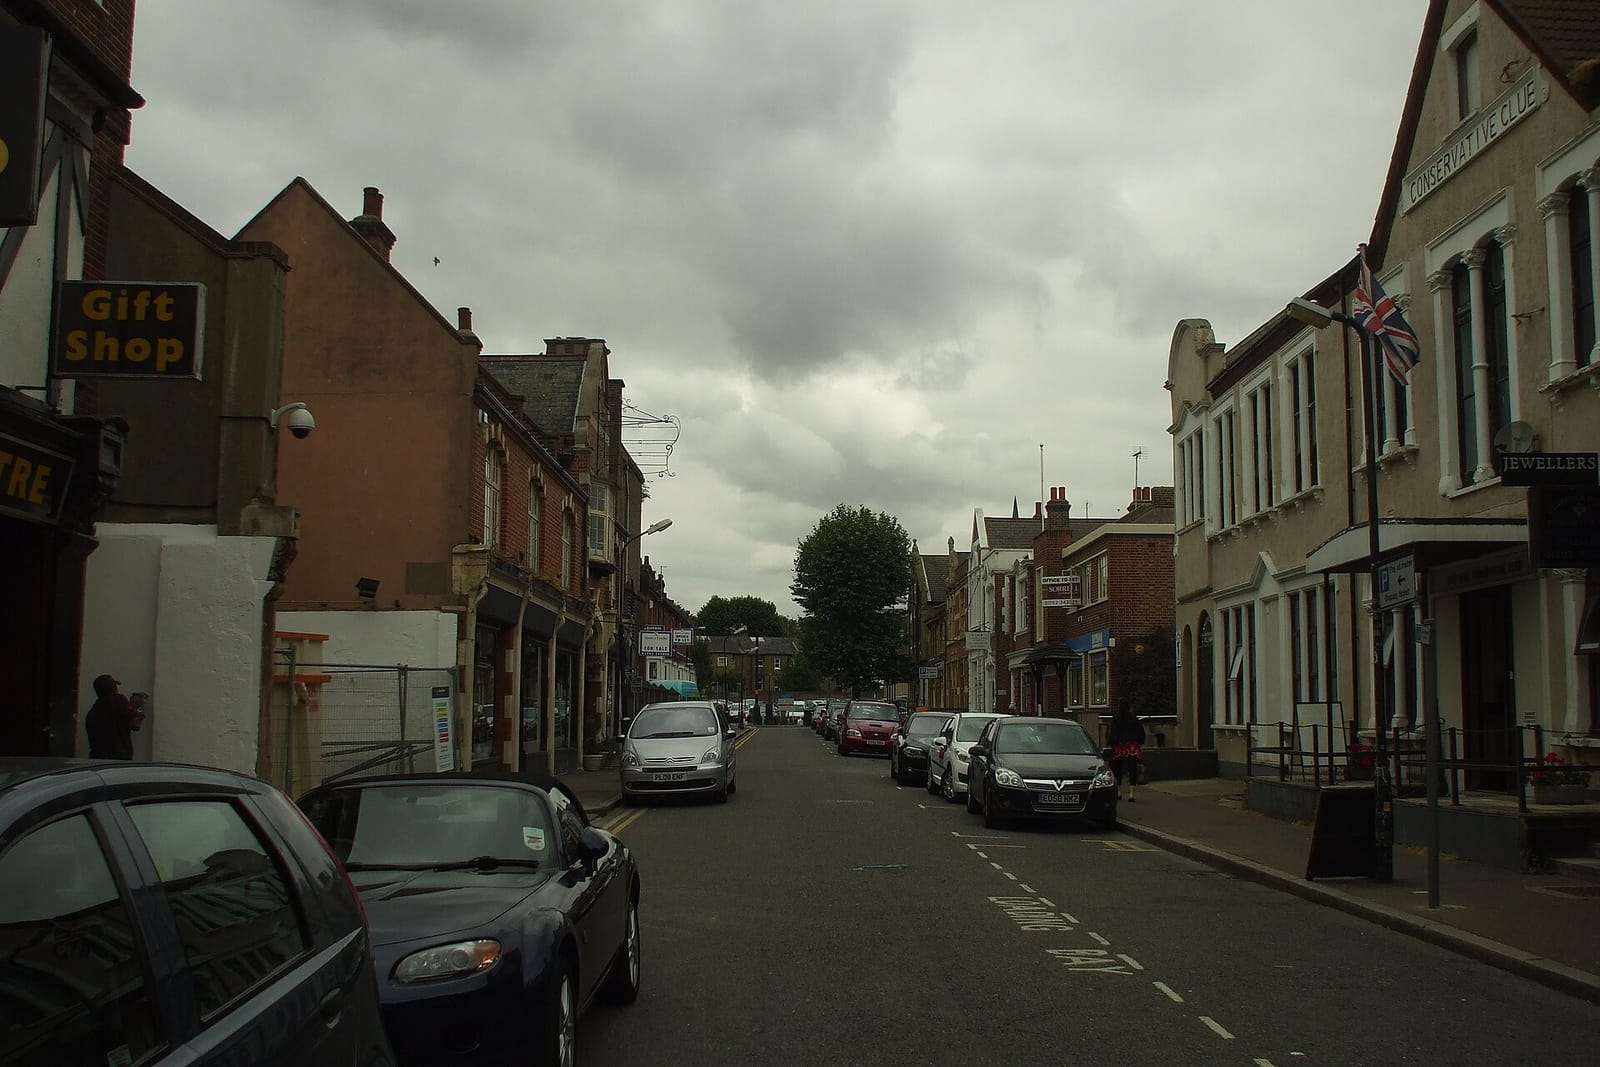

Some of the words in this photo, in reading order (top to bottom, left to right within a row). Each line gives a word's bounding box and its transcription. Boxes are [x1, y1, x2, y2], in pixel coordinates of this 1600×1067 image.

[1409, 112, 1498, 204] CONSERVATIVE
[81, 288, 176, 322] Gift
[64, 329, 185, 372] Shop
[1503, 456, 1597, 472] JEWELLERS
[1045, 948, 1134, 976] BAY
